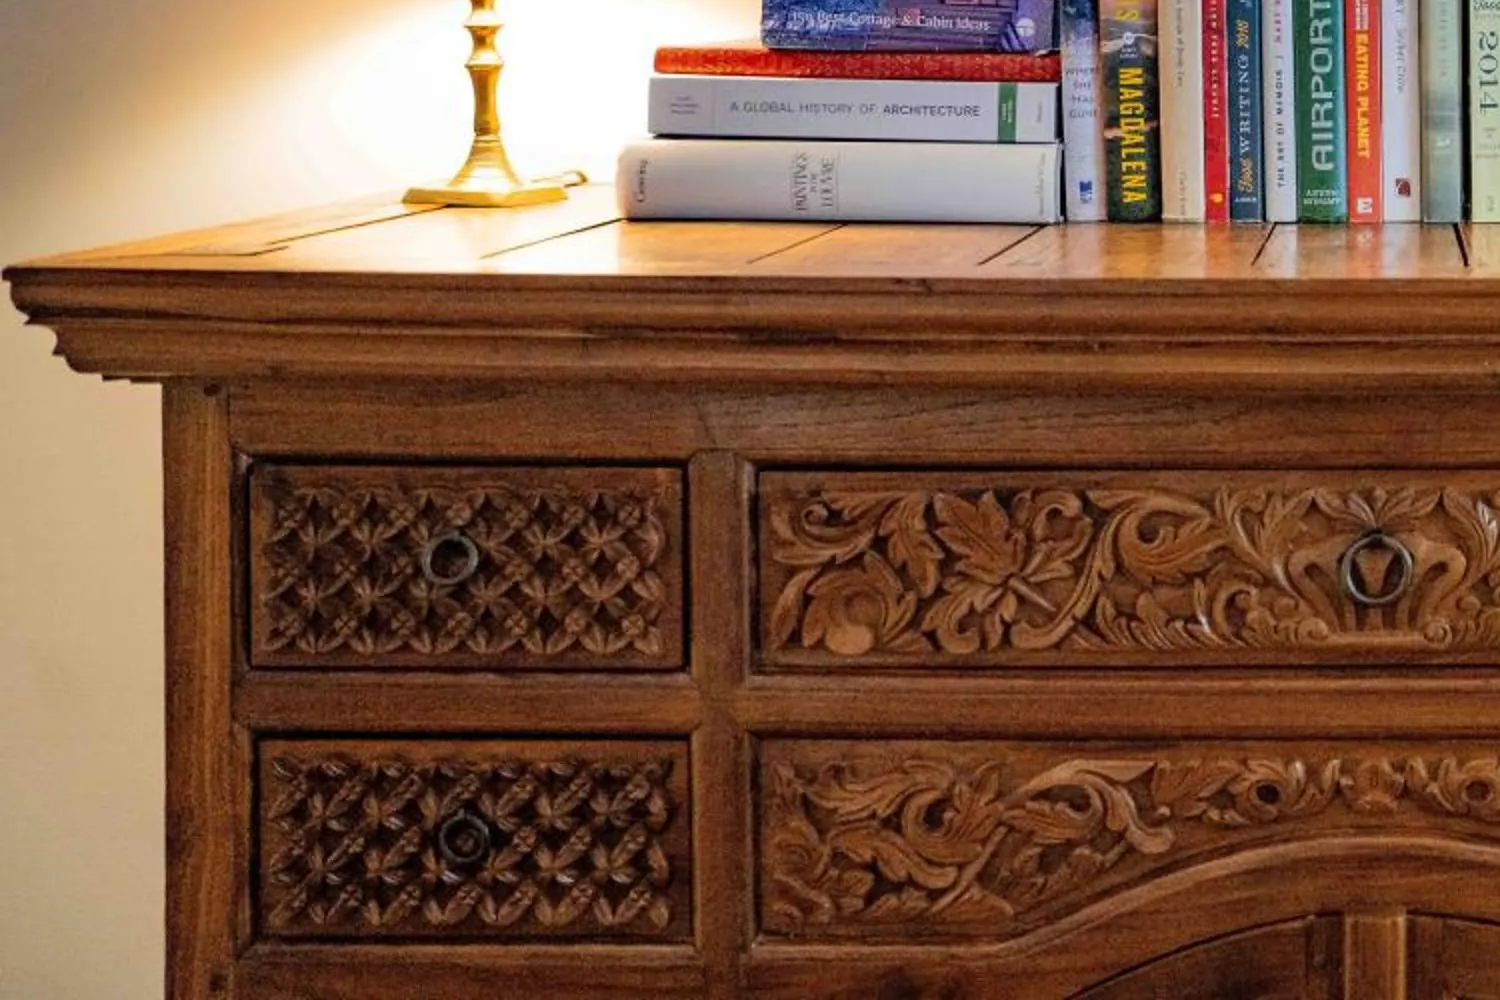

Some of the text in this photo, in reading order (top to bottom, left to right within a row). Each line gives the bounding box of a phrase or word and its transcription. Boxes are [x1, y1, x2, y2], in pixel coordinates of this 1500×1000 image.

[848, 11, 897, 28] Cottage
[901, 14, 912, 26] &
[917, 15, 953, 29] Cabin
[956, 17, 991, 31] Ideas
[1356, 31, 1369, 91] EATING
[1478, 31, 1499, 116] 2014
[729, 101, 981, 117] A GLOBAL HISTORY OF ARCHITECTURE
[1237, 53, 1251, 156] WRITING
[1357, 99, 1370, 158] PLANET
[1118, 67, 1148, 204] MAGDALENA
[1276, 168, 1285, 188] THE
